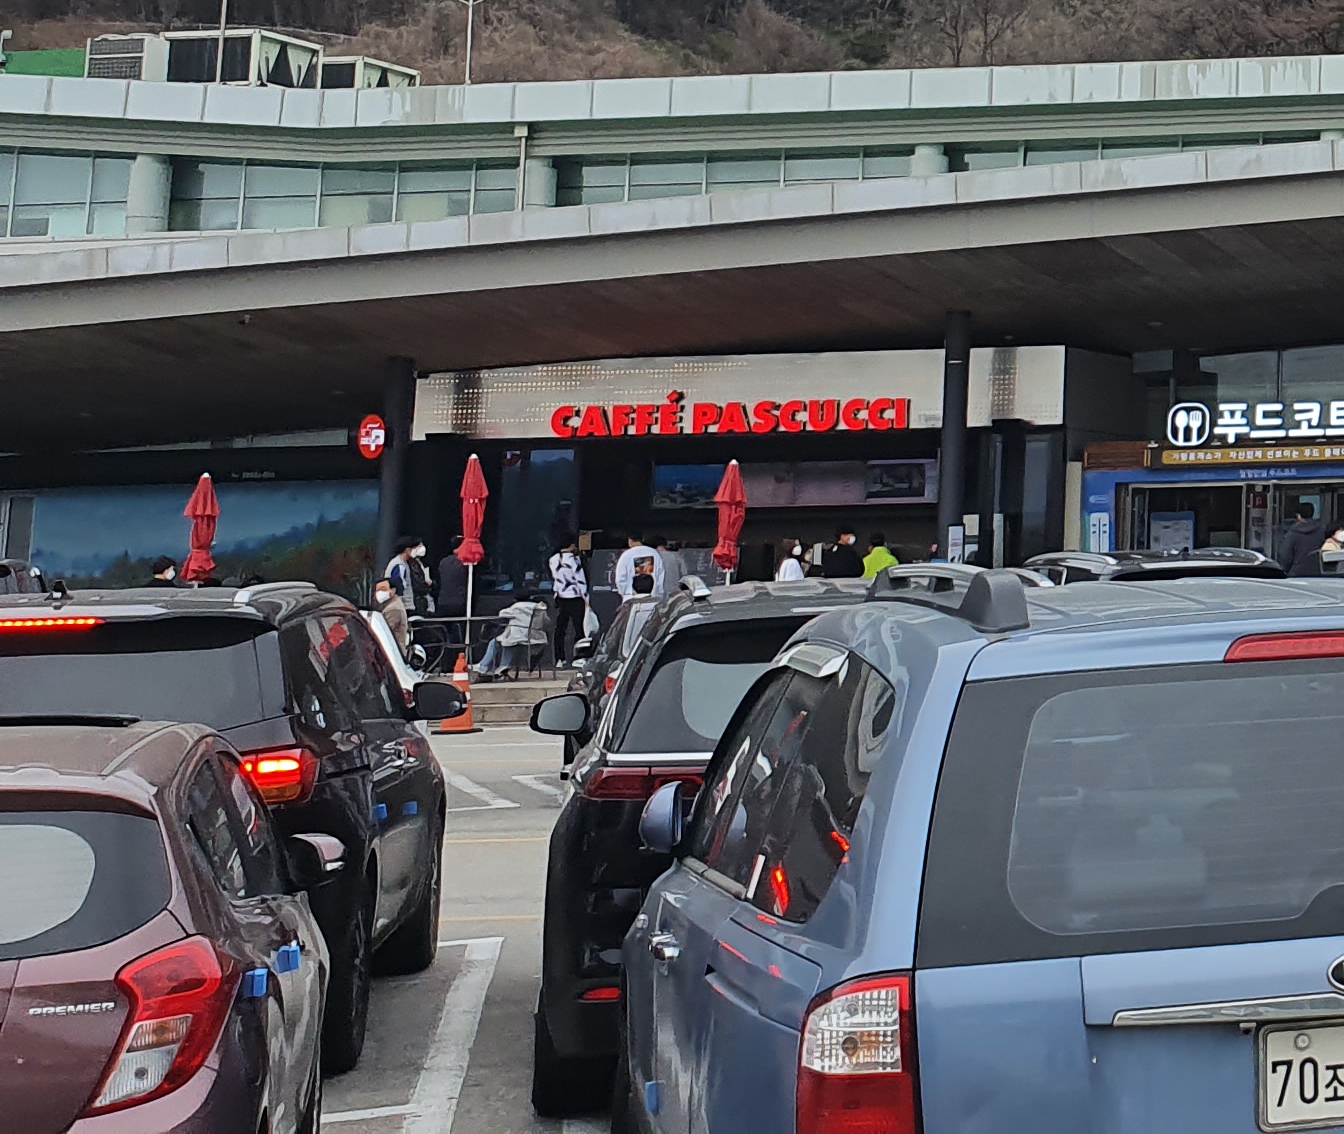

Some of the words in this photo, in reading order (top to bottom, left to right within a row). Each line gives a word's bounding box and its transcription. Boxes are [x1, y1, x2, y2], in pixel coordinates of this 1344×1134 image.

[550, 389, 684, 439] CAFFÉ
[692, 397, 909, 435] PASCUCCI
[28, 1001, 116, 1017] PREMIER
